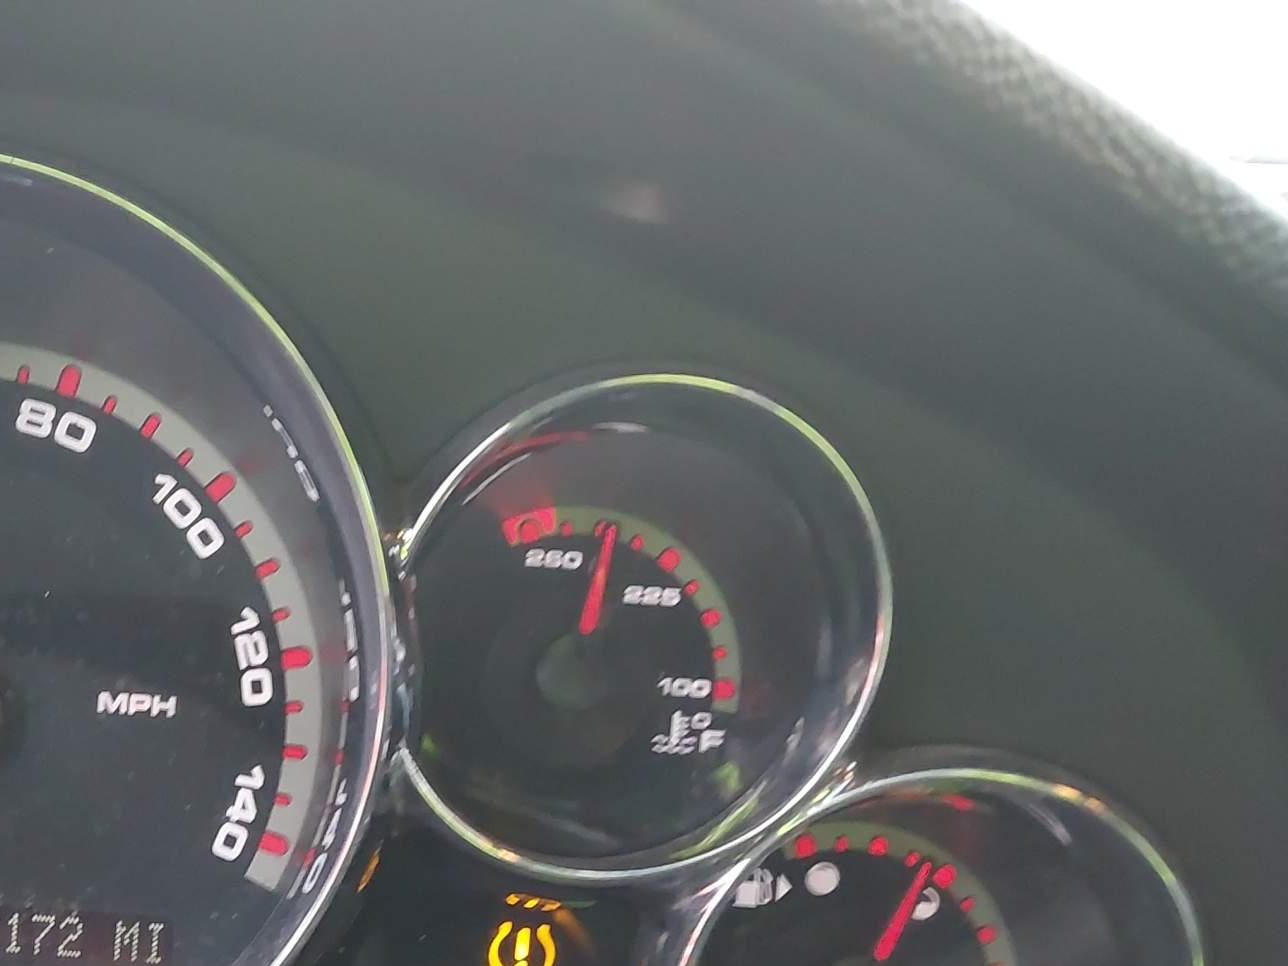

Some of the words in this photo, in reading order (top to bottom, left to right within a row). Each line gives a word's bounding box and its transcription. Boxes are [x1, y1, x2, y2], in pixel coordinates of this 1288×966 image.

[15, 400, 96, 453] 80
[152, 473, 224, 559] 100
[621, 585, 682, 607] 225
[229, 606, 274, 707] 120
[95, 690, 178, 718] MPH
[657, 677, 712, 699] 100
[212, 764, 266, 862] 140
[113, 920, 165, 965] MI
